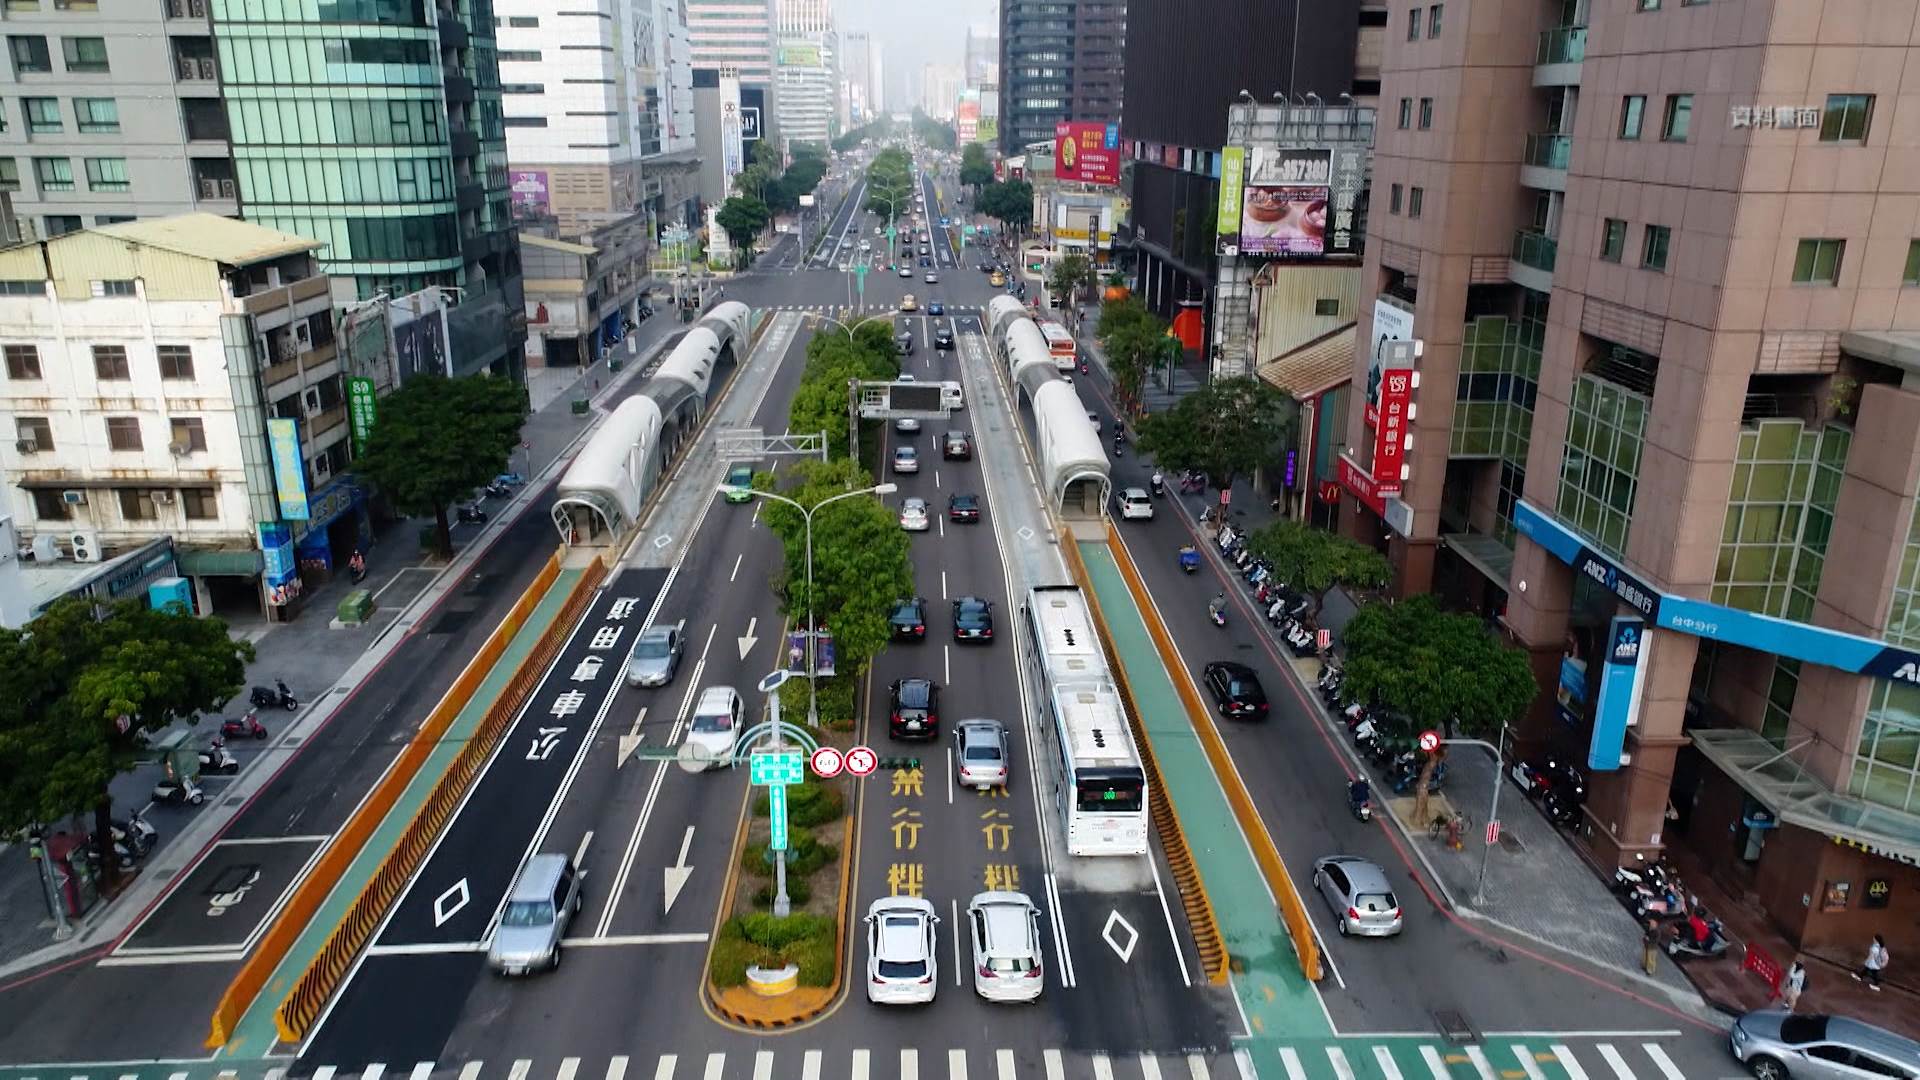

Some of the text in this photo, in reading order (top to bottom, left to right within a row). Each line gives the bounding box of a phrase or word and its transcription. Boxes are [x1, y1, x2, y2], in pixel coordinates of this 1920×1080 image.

[1384, 401, 1401, 456] 台新銀行
[1583, 559, 1607, 584] ANZ
[1671, 615, 1719, 634] 台中分行
